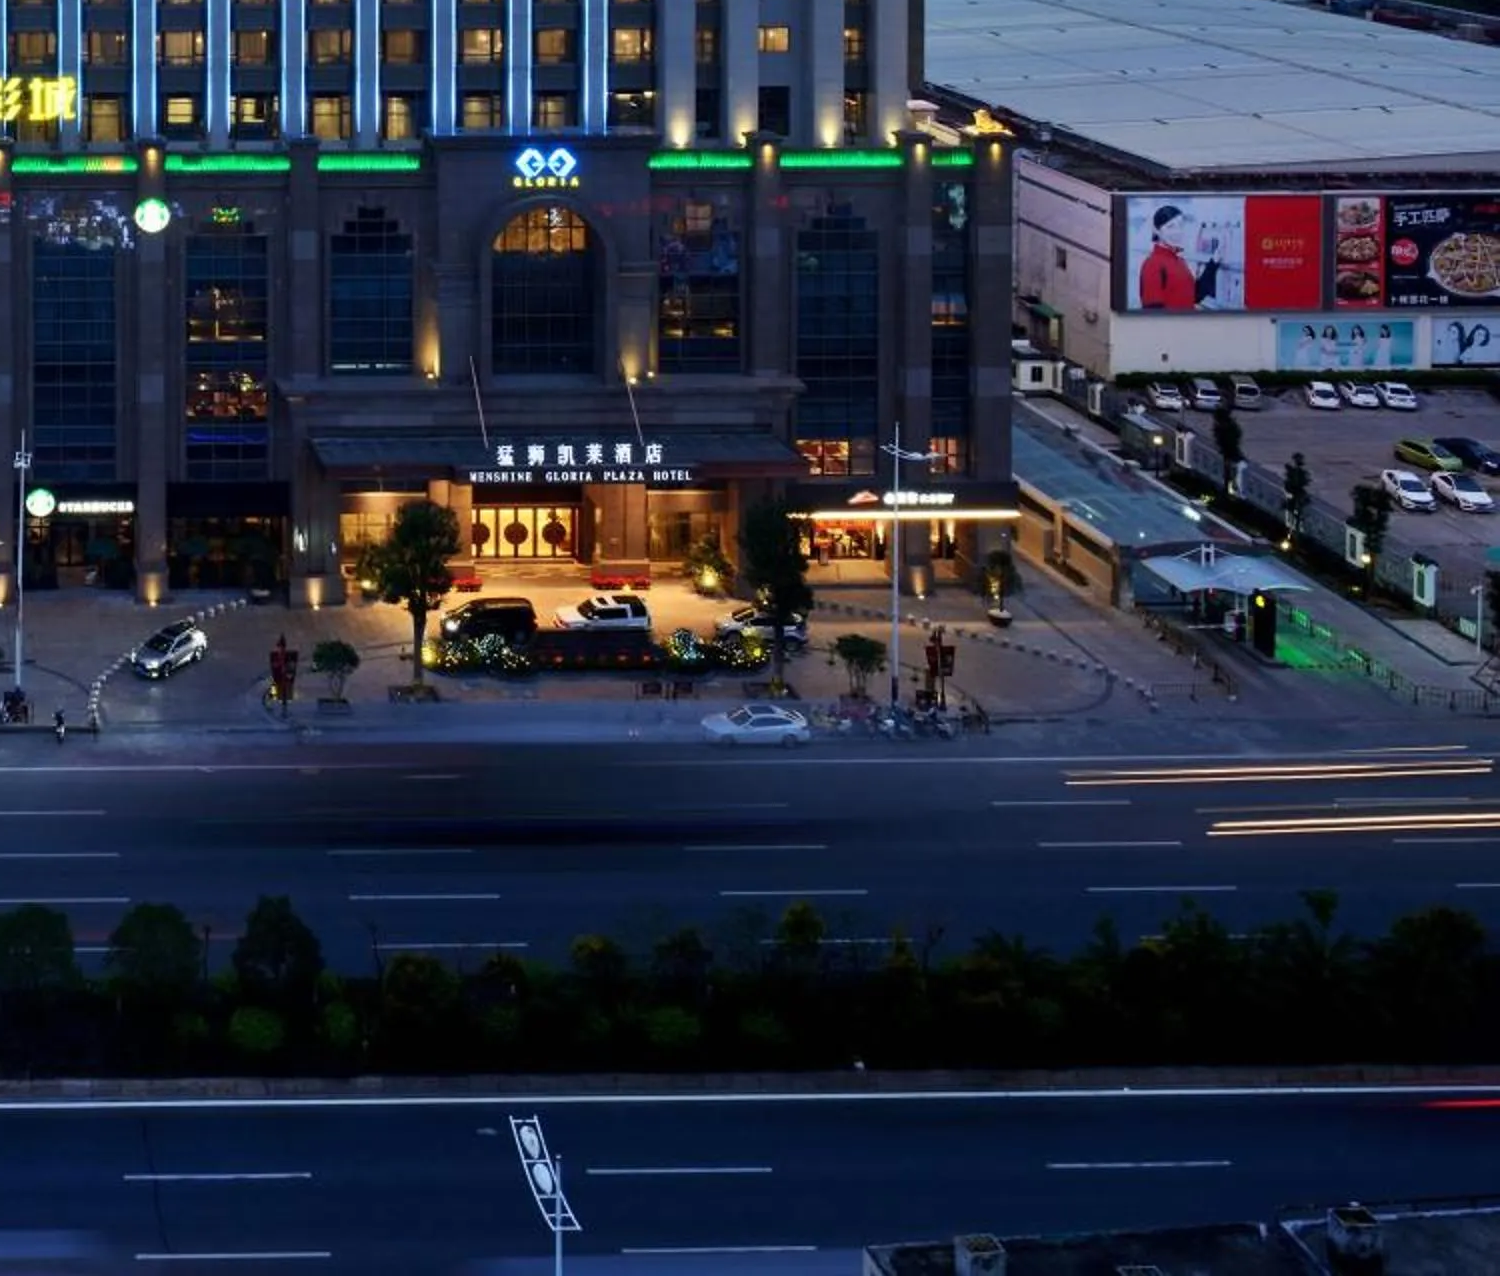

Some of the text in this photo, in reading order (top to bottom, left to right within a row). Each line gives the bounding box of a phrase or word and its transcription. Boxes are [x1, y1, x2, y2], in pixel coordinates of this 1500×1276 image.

[513, 176, 579, 187] GLORIA
[496, 443, 663, 466] 猛狮凯莱酒店
[469, 470, 693, 482] MENSHINE GLORIA PLAZA HOTEL
